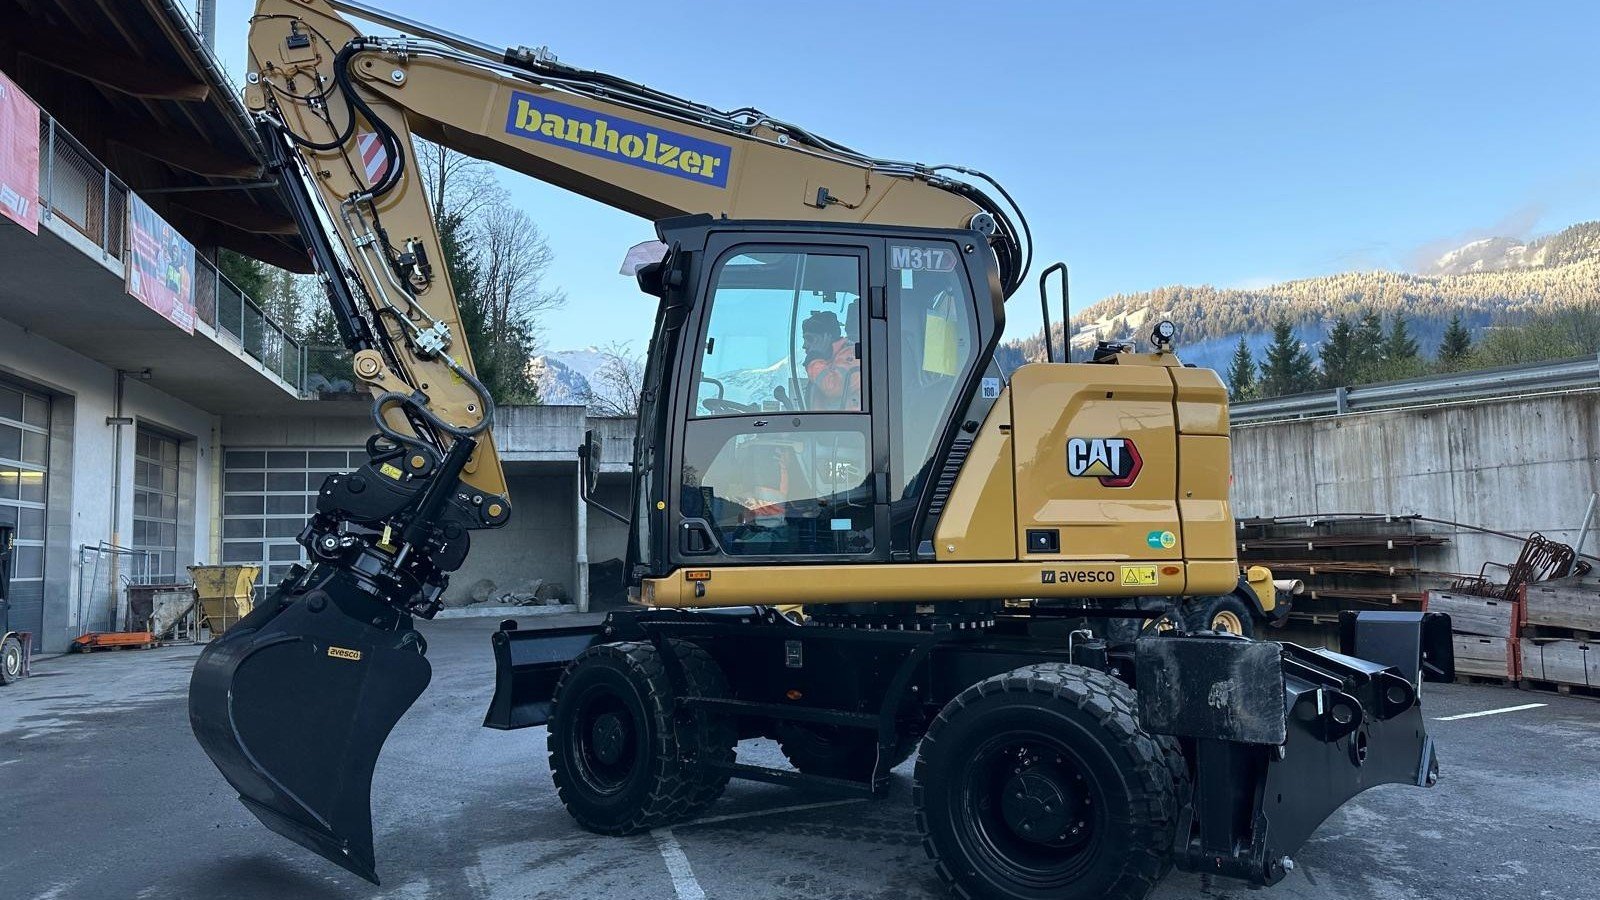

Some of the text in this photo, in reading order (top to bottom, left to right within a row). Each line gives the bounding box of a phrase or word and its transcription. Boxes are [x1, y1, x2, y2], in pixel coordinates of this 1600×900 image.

[514, 99, 721, 179] banholzer
[892, 248, 944, 269] M317
[1068, 438, 1125, 476] CAT
[1059, 570, 1115, 583] avesco
[330, 648, 359, 659] avesco
